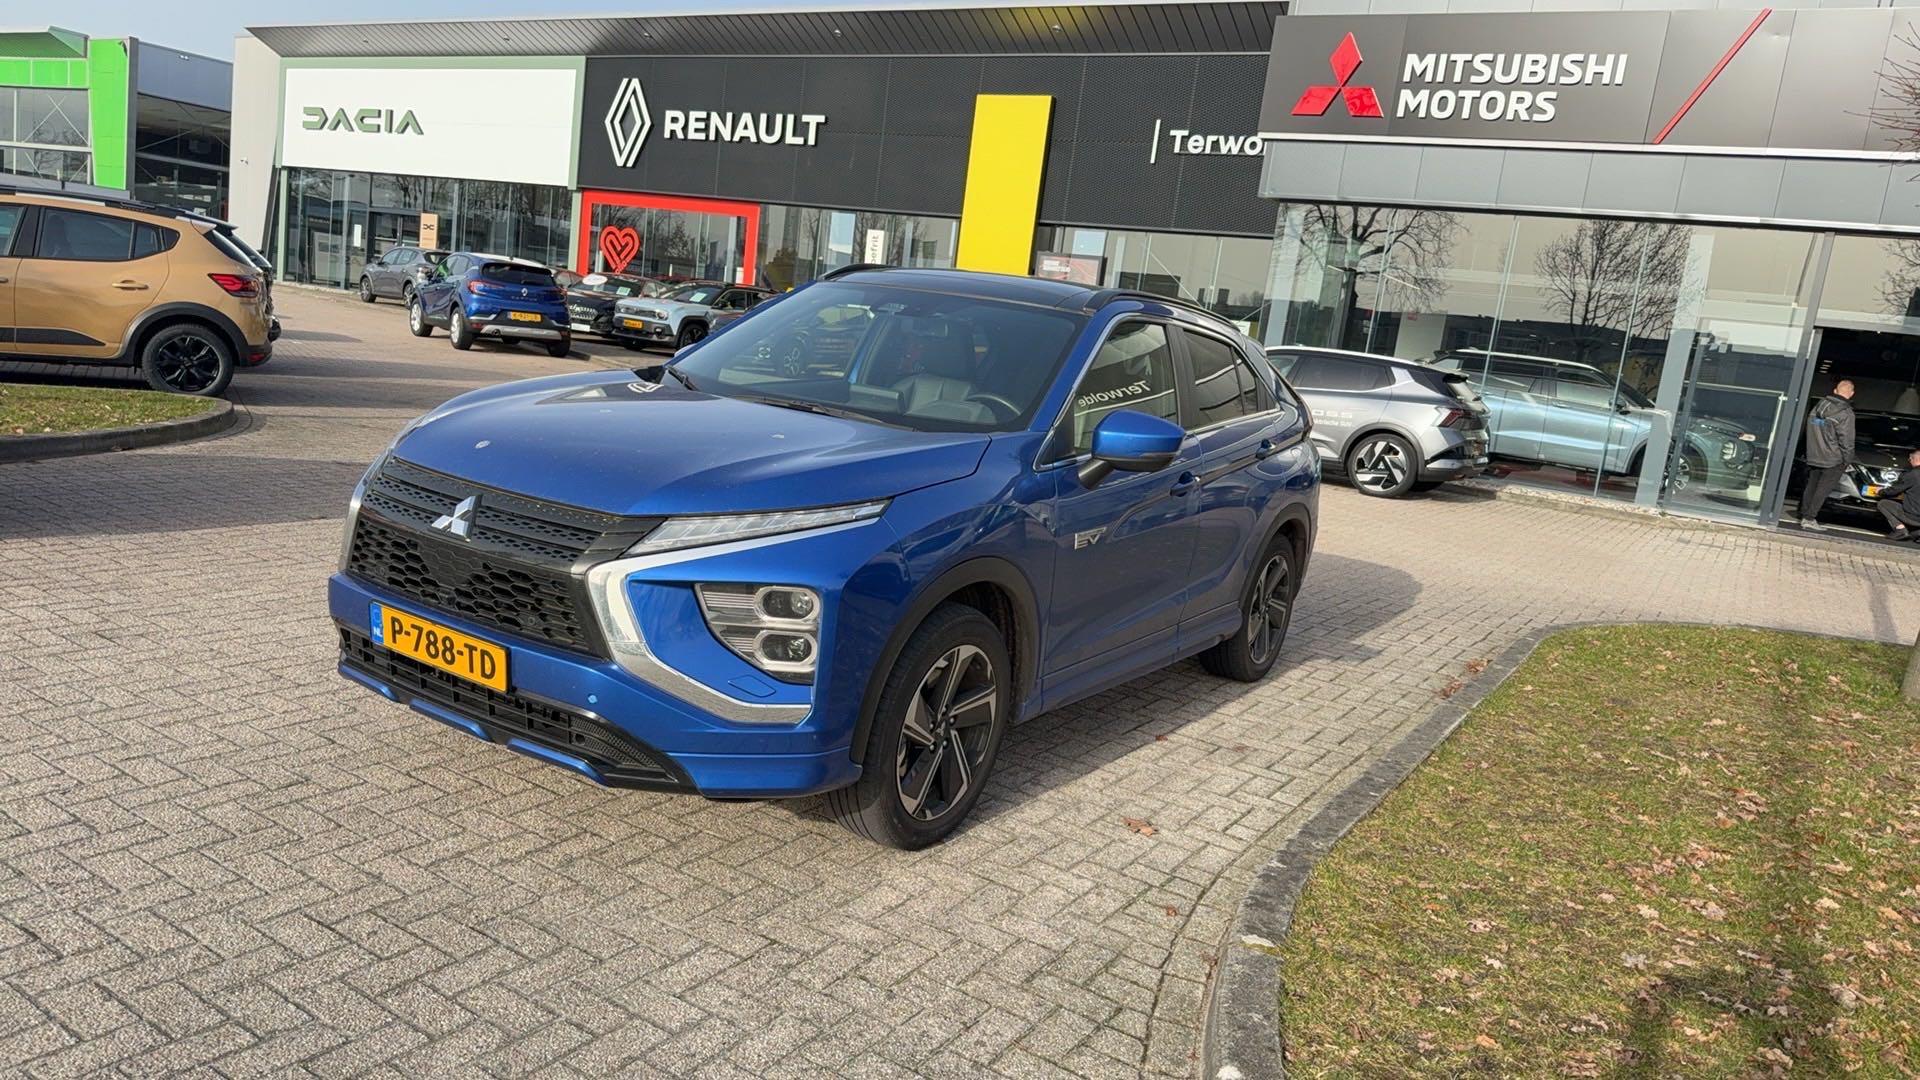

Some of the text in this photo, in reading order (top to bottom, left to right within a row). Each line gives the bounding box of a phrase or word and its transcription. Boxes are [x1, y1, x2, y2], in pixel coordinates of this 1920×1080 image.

[1403, 54, 1628, 86] MITSUBISHI
[302, 105, 424, 136] DACIA
[1397, 89, 1558, 122] MOTORS
[663, 109, 827, 146] RENAULT
[373, 627, 383, 638] NL
[390, 615, 496, 680] P-788-TD
